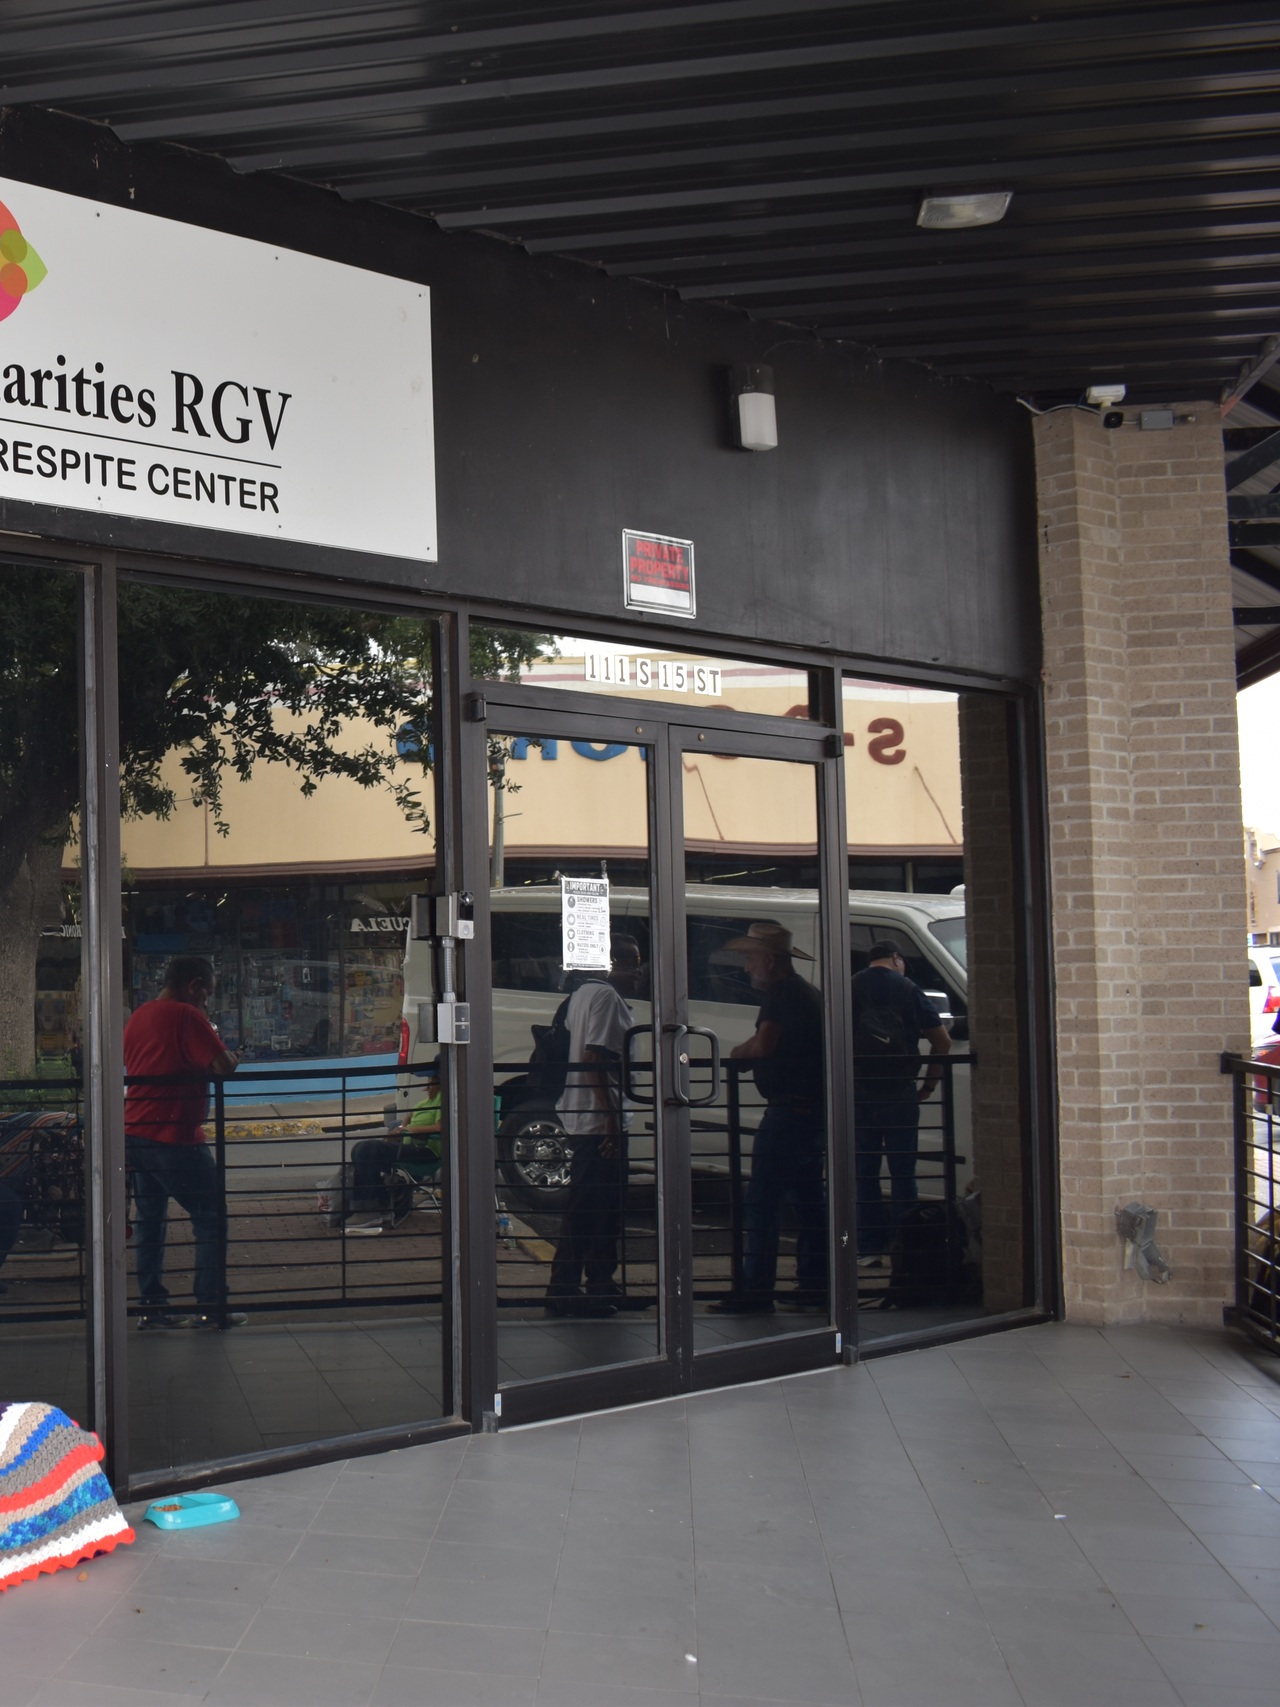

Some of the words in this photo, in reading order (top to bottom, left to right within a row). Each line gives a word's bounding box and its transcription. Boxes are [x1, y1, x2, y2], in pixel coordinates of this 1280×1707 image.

[170, 370, 292, 450] RGV
[147, 463, 280, 514] CENTER
[635, 539, 683, 563] PRIVATE
[630, 557, 689, 582] PROPERTY
[589, 654, 626, 682] 111
[639, 660, 649, 685] S
[662, 664, 685, 689] 15
[697, 668, 720, 693] ST
[569, 881, 600, 892] IMPORTANT
